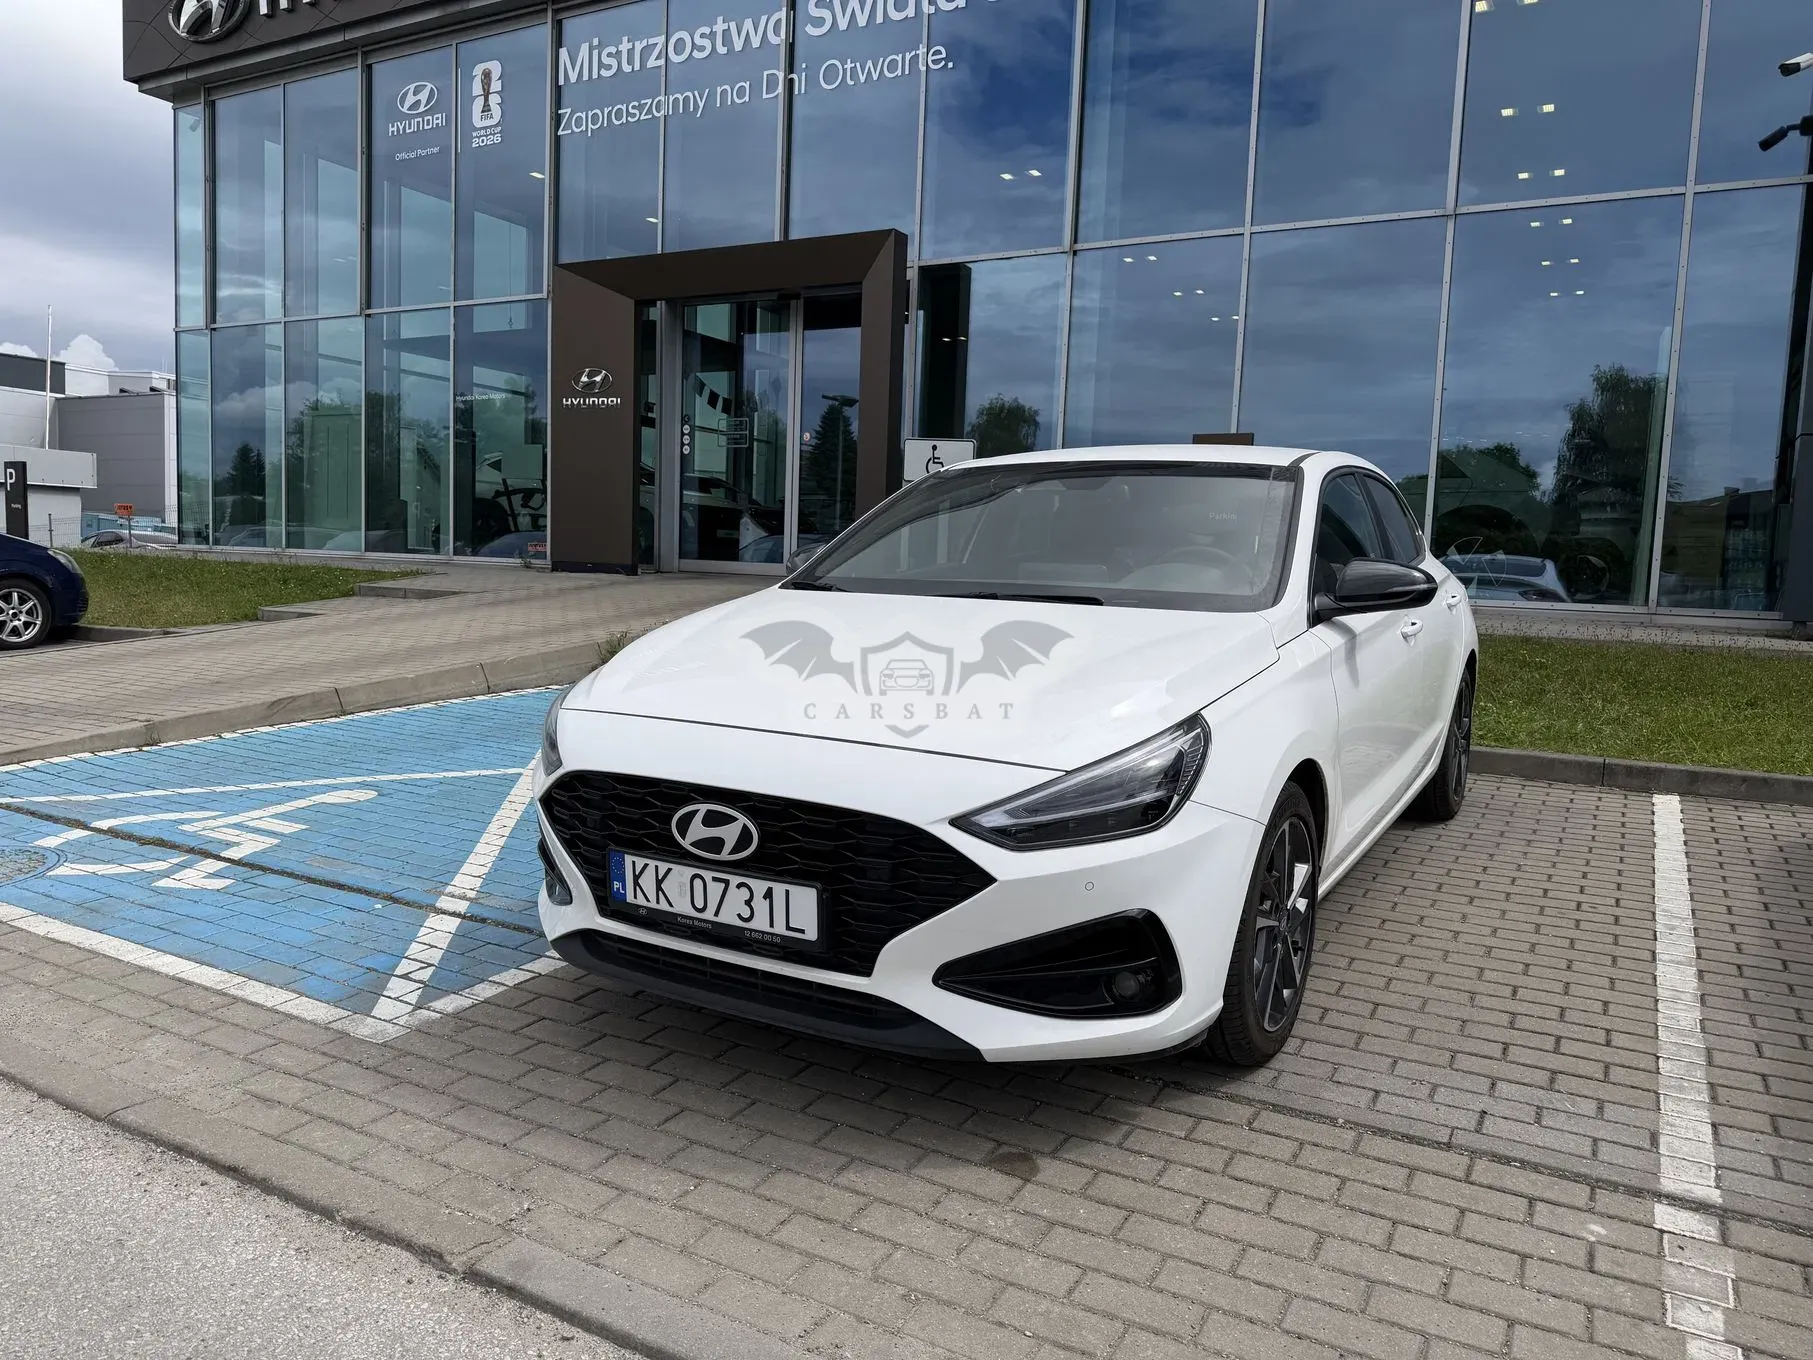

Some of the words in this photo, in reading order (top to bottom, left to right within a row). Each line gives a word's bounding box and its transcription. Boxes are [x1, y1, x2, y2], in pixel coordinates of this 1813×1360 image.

[557, 88, 710, 136] Zapraszamy
[716, 80, 751, 107] na
[762, 63, 807, 99] Dni
[819, 43, 954, 91] Otwarte.
[388, 112, 446, 136] HYUNDAI
[480, 113, 494, 121] FIFA
[472, 128, 490, 137] WORLD
[490, 126, 502, 134] CUP
[472, 134, 502, 147] 2026
[395, 149, 417, 161] Official
[417, 146, 440, 158] Partner
[6, 468, 16, 491] P
[613, 880, 625, 894] PL
[631, 860, 675, 908] KK
[689, 872, 806, 935] 0731L
[693, 918, 712, 929] Motors
